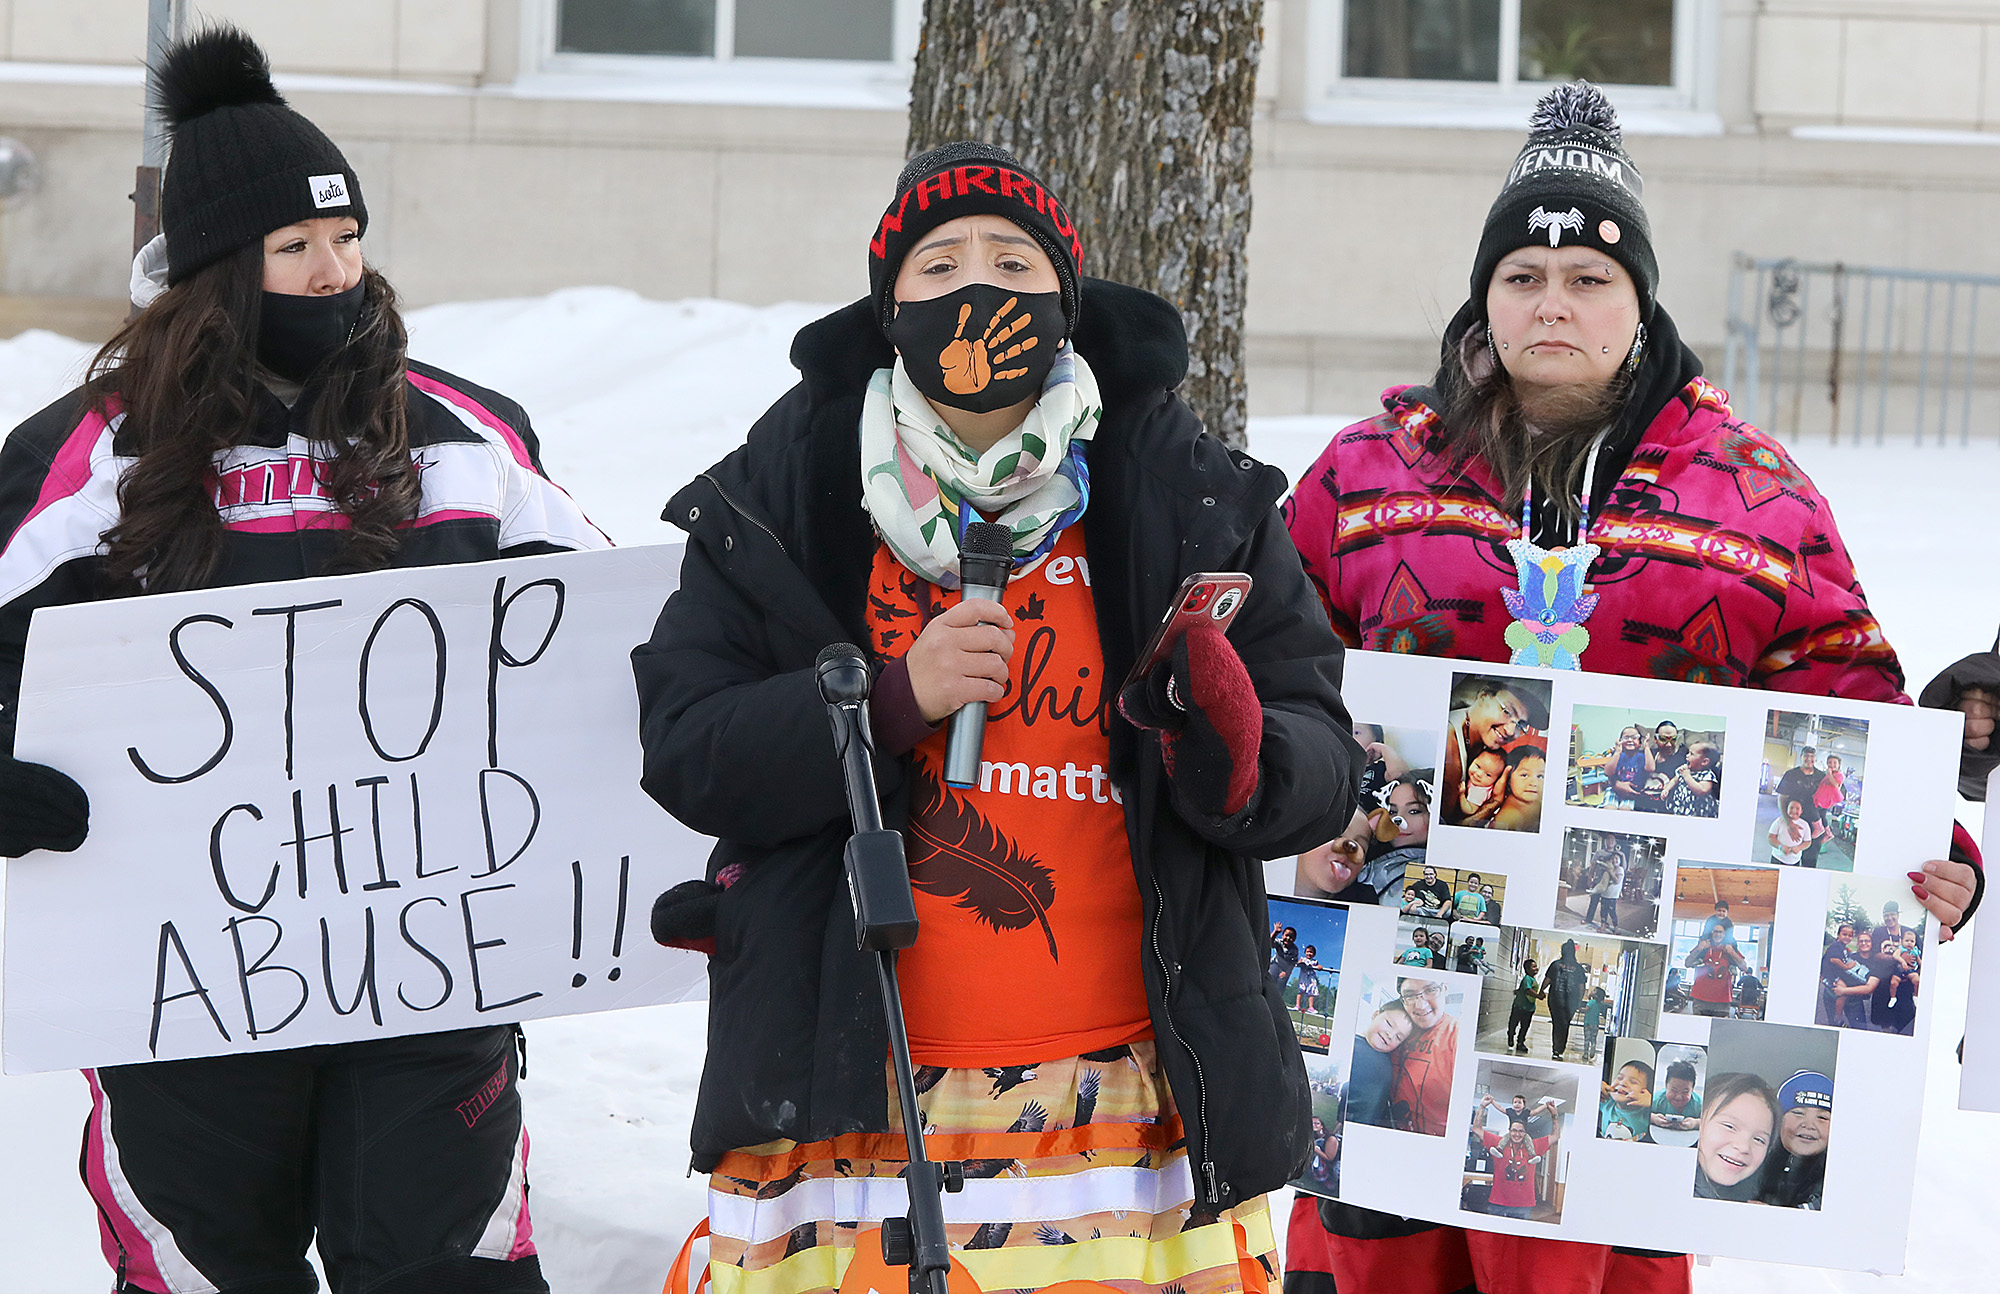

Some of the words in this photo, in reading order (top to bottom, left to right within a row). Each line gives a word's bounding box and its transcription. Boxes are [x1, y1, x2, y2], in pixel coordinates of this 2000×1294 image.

[318, 179, 345, 203] sota
[1508, 148, 1625, 187] VENOM
[126, 575, 566, 784] STOP
[209, 769, 541, 914] CHILD
